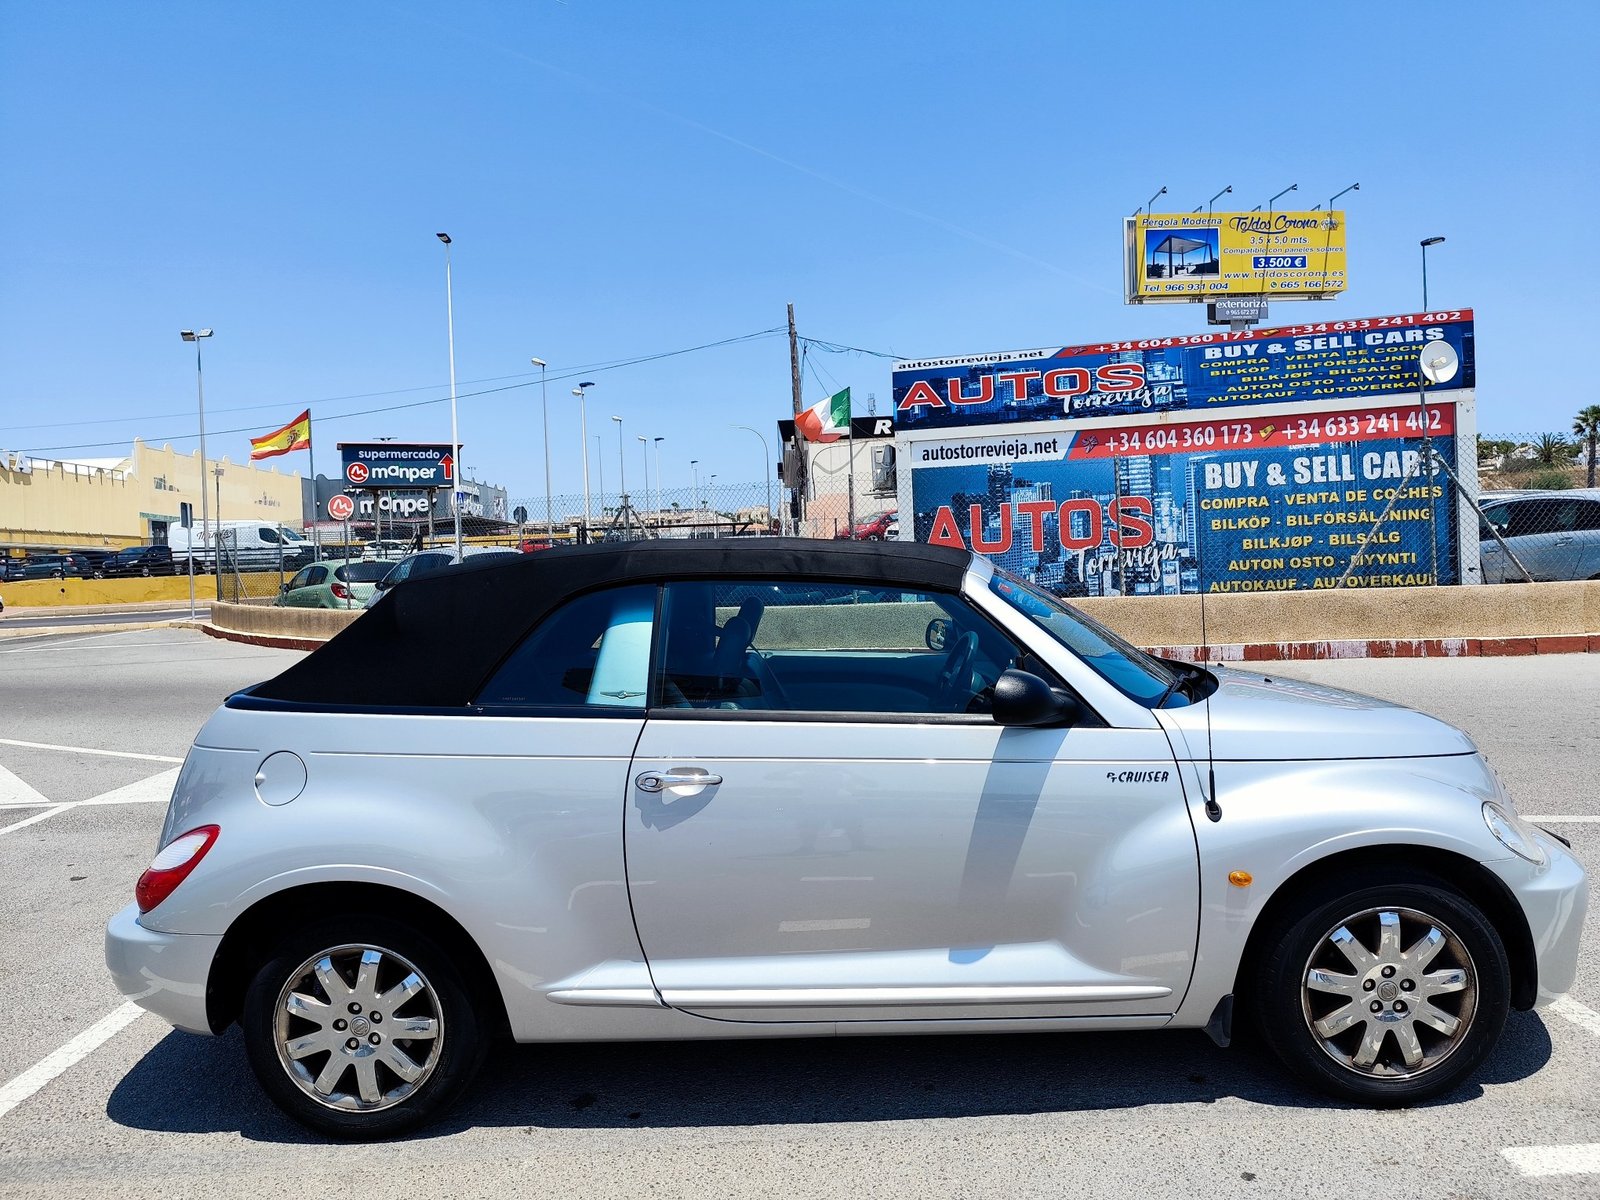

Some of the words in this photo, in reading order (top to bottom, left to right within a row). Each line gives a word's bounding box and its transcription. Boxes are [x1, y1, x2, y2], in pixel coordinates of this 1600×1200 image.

[1142, 218, 1178, 228] Pergola
[1182, 217, 1222, 226] Moderna
[1229, 216, 1271, 233] Toldos
[1275, 215, 1319, 230] Corona
[1275, 236, 1288, 245] 5,0
[1290, 236, 1310, 244] mts.
[1223, 247, 1267, 255] Compatible
[1285, 246, 1314, 254] paneles
[1257, 257, 1292, 268] 3.500
[1294, 257, 1303, 267] €
[1144, 284, 1161, 292] Tel.
[1165, 283, 1185, 291] 966
[1187, 283, 1206, 291] 931
[1209, 282, 1229, 290] 004
[1280, 281, 1300, 289] 665
[1324, 280, 1344, 288] 572
[1216, 299, 1268, 309] exterioriza
[1094, 341, 1133, 353] +34
[1137, 339, 1174, 349] 604
[1178, 335, 1214, 345] 360
[1220, 330, 1254, 341] 173
[1286, 321, 1328, 335] +34
[1333, 319, 1371, 331] 633
[1378, 315, 1414, 328] 241
[1423, 311, 1462, 323] 402
[1204, 343, 1259, 360] BUY
[1266, 343, 1287, 354] &
[1294, 335, 1357, 352] SELL
[1364, 327, 1445, 346] CARS
[898, 350, 1045, 370] autostorrevieja.net
[1200, 357, 1269, 369] COMPRA
[1285, 351, 1341, 361] VENTA
[1346, 349, 1369, 357] DE
[1374, 344, 1424, 354] COCH
[1210, 366, 1270, 377] BILKÖP
[1286, 354, 1421, 370] BILFÖRSÄLJNIN
[1227, 383, 1284, 393] AUTON
[1289, 378, 1334, 387] OSTO
[1350, 372, 1418, 383] MYYNTI
[1241, 371, 1313, 383] BILKJØP
[1329, 364, 1402, 375] BILSALG
[897, 362, 1146, 411] AUTOS
[1056, 384, 1172, 414] Torrevieja
[1207, 390, 1297, 403] AUTOKAUF
[1105, 431, 1140, 453] +34
[1145, 429, 1178, 450] 604
[1182, 426, 1215, 447] 360
[1220, 423, 1254, 445] 173
[1281, 418, 1321, 441] +34
[1325, 415, 1360, 436] 633
[1366, 412, 1399, 434] 241
[1405, 409, 1442, 431] 402
[358, 449, 441, 461] supermercado
[922, 438, 1058, 461] autostorrevieja.net
[371, 465, 437, 482] manper
[1204, 459, 1260, 490] BUY
[1266, 463, 1286, 486] &
[1293, 453, 1356, 485] SELL
[1201, 496, 1270, 510] COMPRA
[1284, 492, 1340, 506] VENTA
[1345, 489, 1367, 502] DE
[1372, 486, 1443, 501] COCHES
[928, 495, 1153, 554] AUTOS
[1211, 515, 1271, 530] BILKÖP
[1286, 508, 1431, 527] BILFÖRSÄLNING
[1242, 535, 1313, 550] BILKJØP
[1329, 531, 1401, 546] BILSALG
[1228, 558, 1284, 571] AUTON
[1289, 556, 1335, 568] OSTO
[1209, 578, 1297, 593] AUTOKAUF
[1118, 771, 1170, 783] CRUISER
